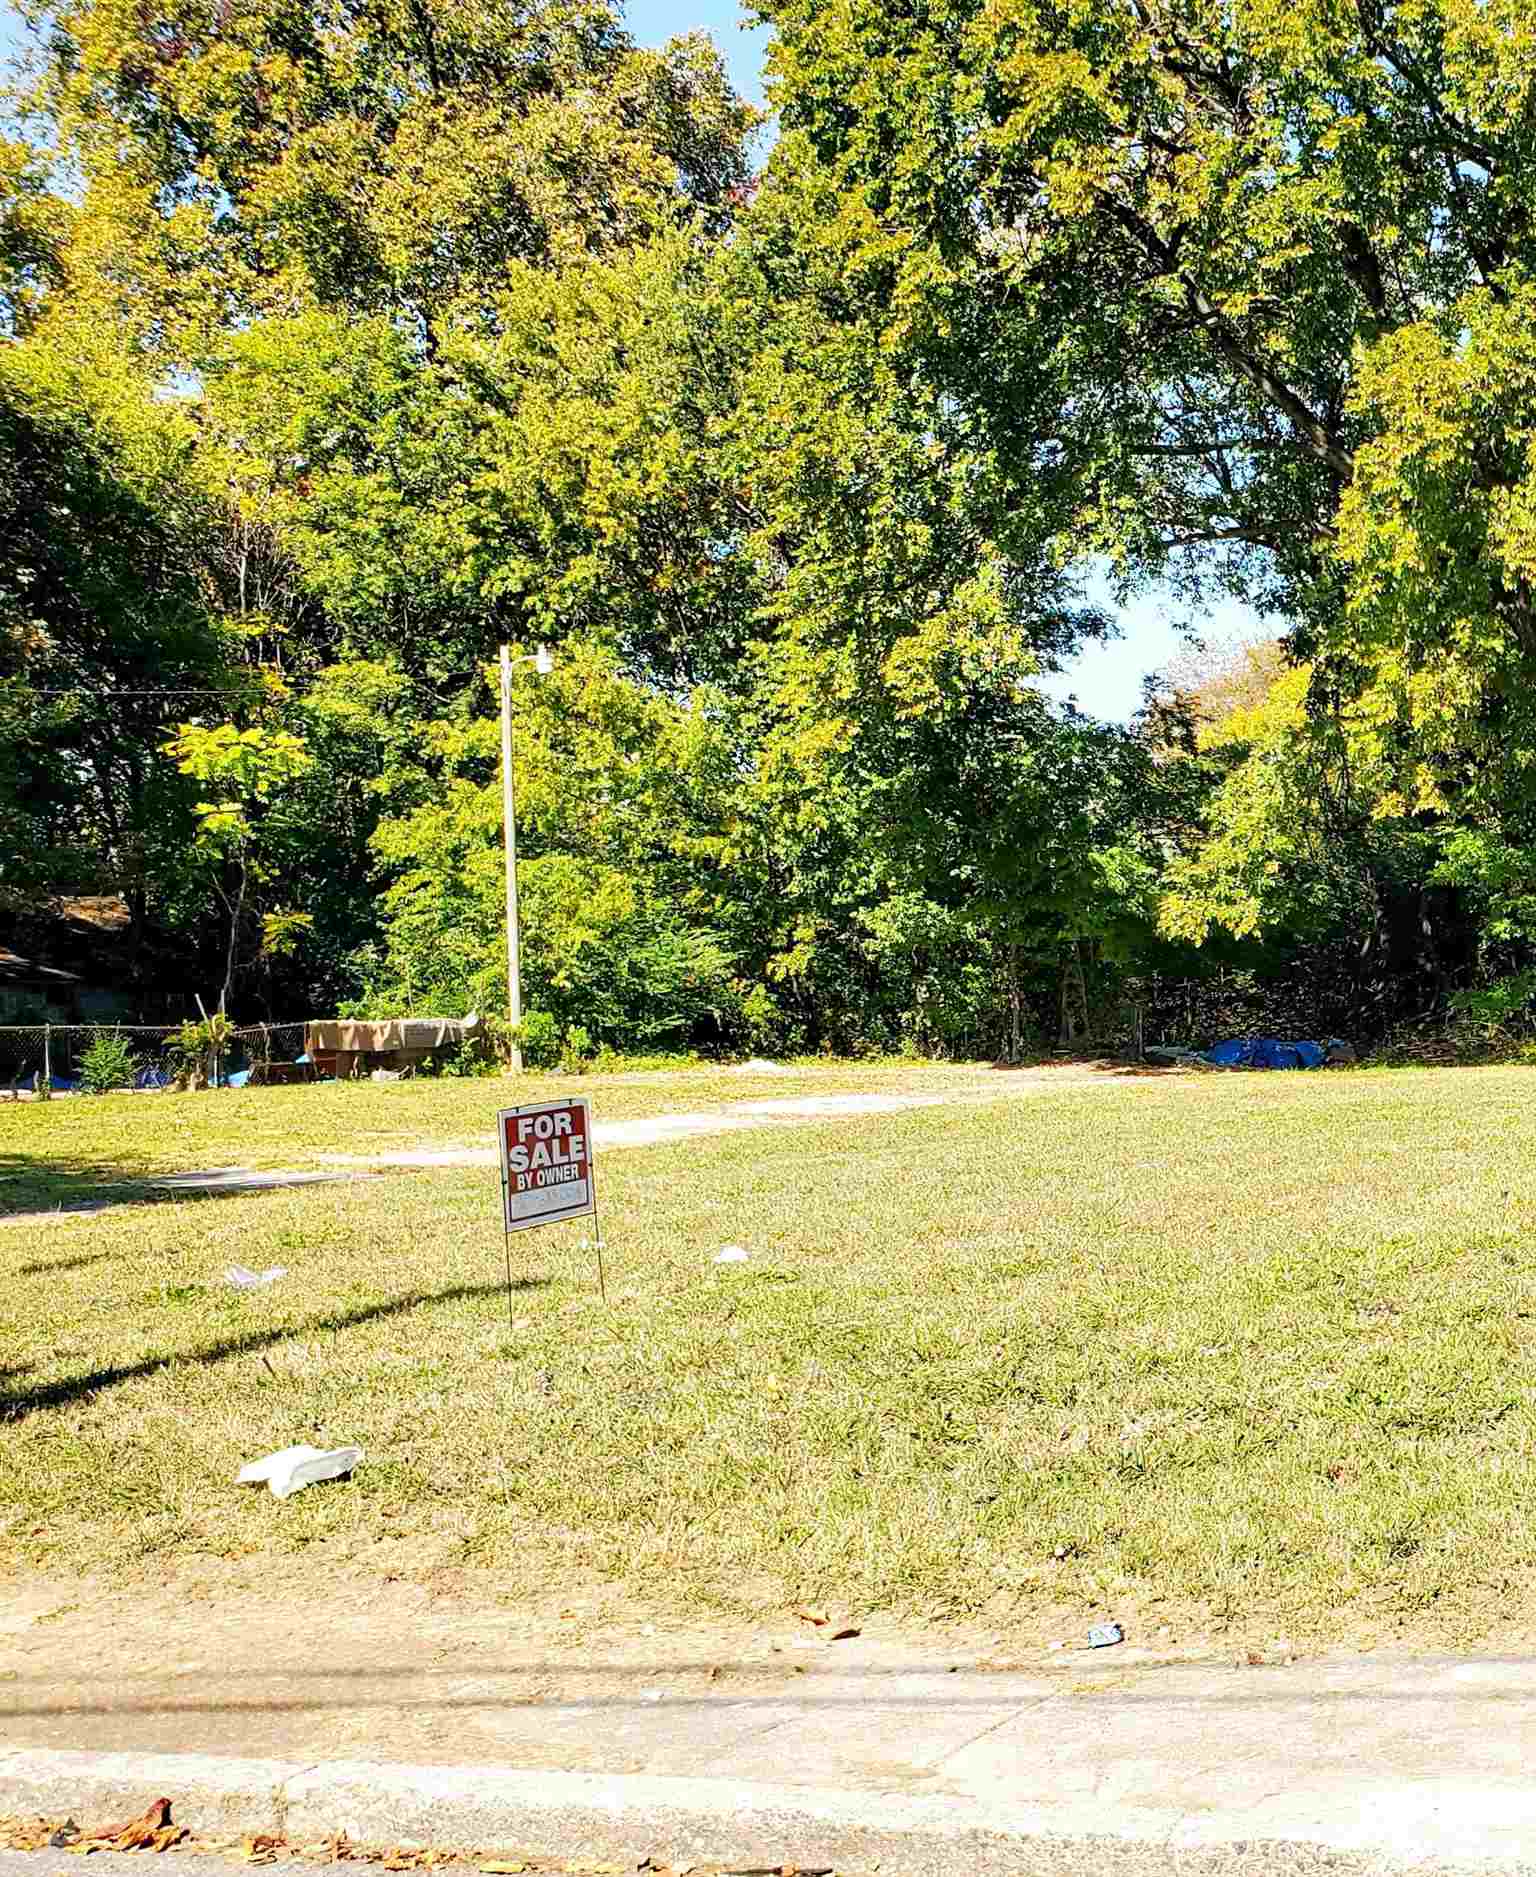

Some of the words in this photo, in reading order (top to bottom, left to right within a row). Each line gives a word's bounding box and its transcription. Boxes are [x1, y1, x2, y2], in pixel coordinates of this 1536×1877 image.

[518, 1112, 572, 1142] FOR
[510, 1135, 585, 1172] SALE
[517, 1172, 533, 1190] BY
[537, 1163, 579, 1186] OWNER
